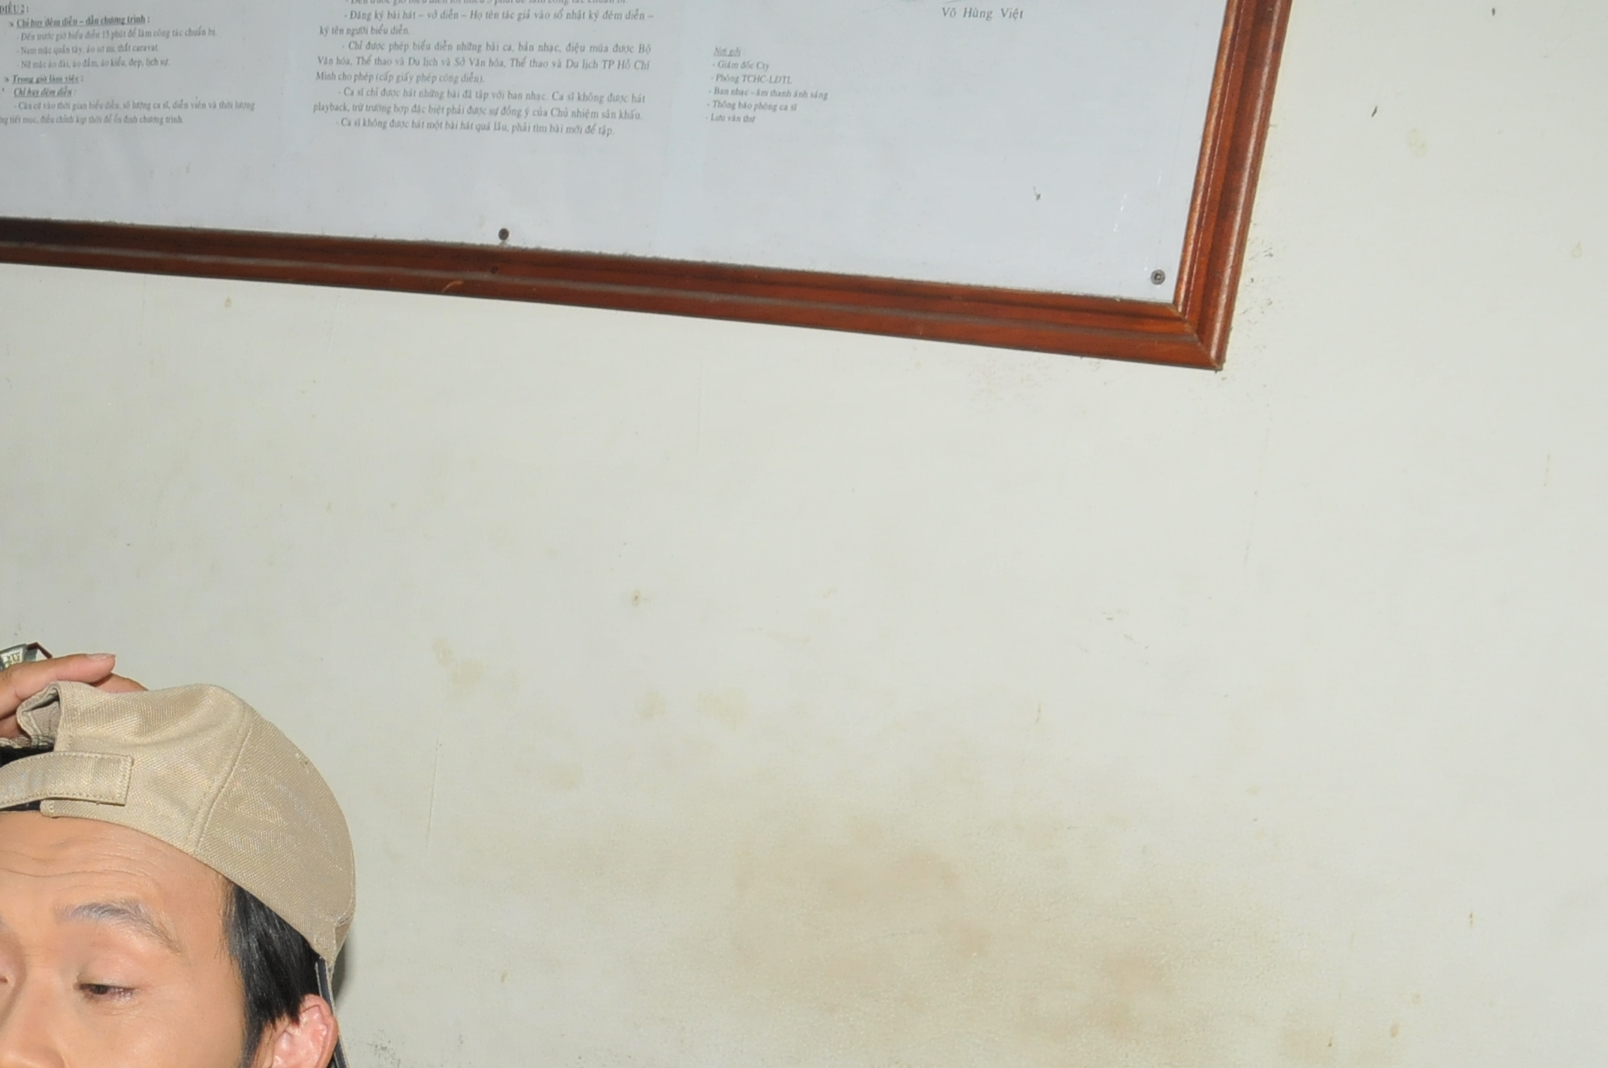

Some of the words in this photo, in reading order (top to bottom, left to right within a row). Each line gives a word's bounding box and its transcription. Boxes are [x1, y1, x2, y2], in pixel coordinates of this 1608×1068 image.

[963, 7, 993, 22] Hùng
[1000, 7, 1024, 21] Việt
[601, 58, 615, 69] TP
